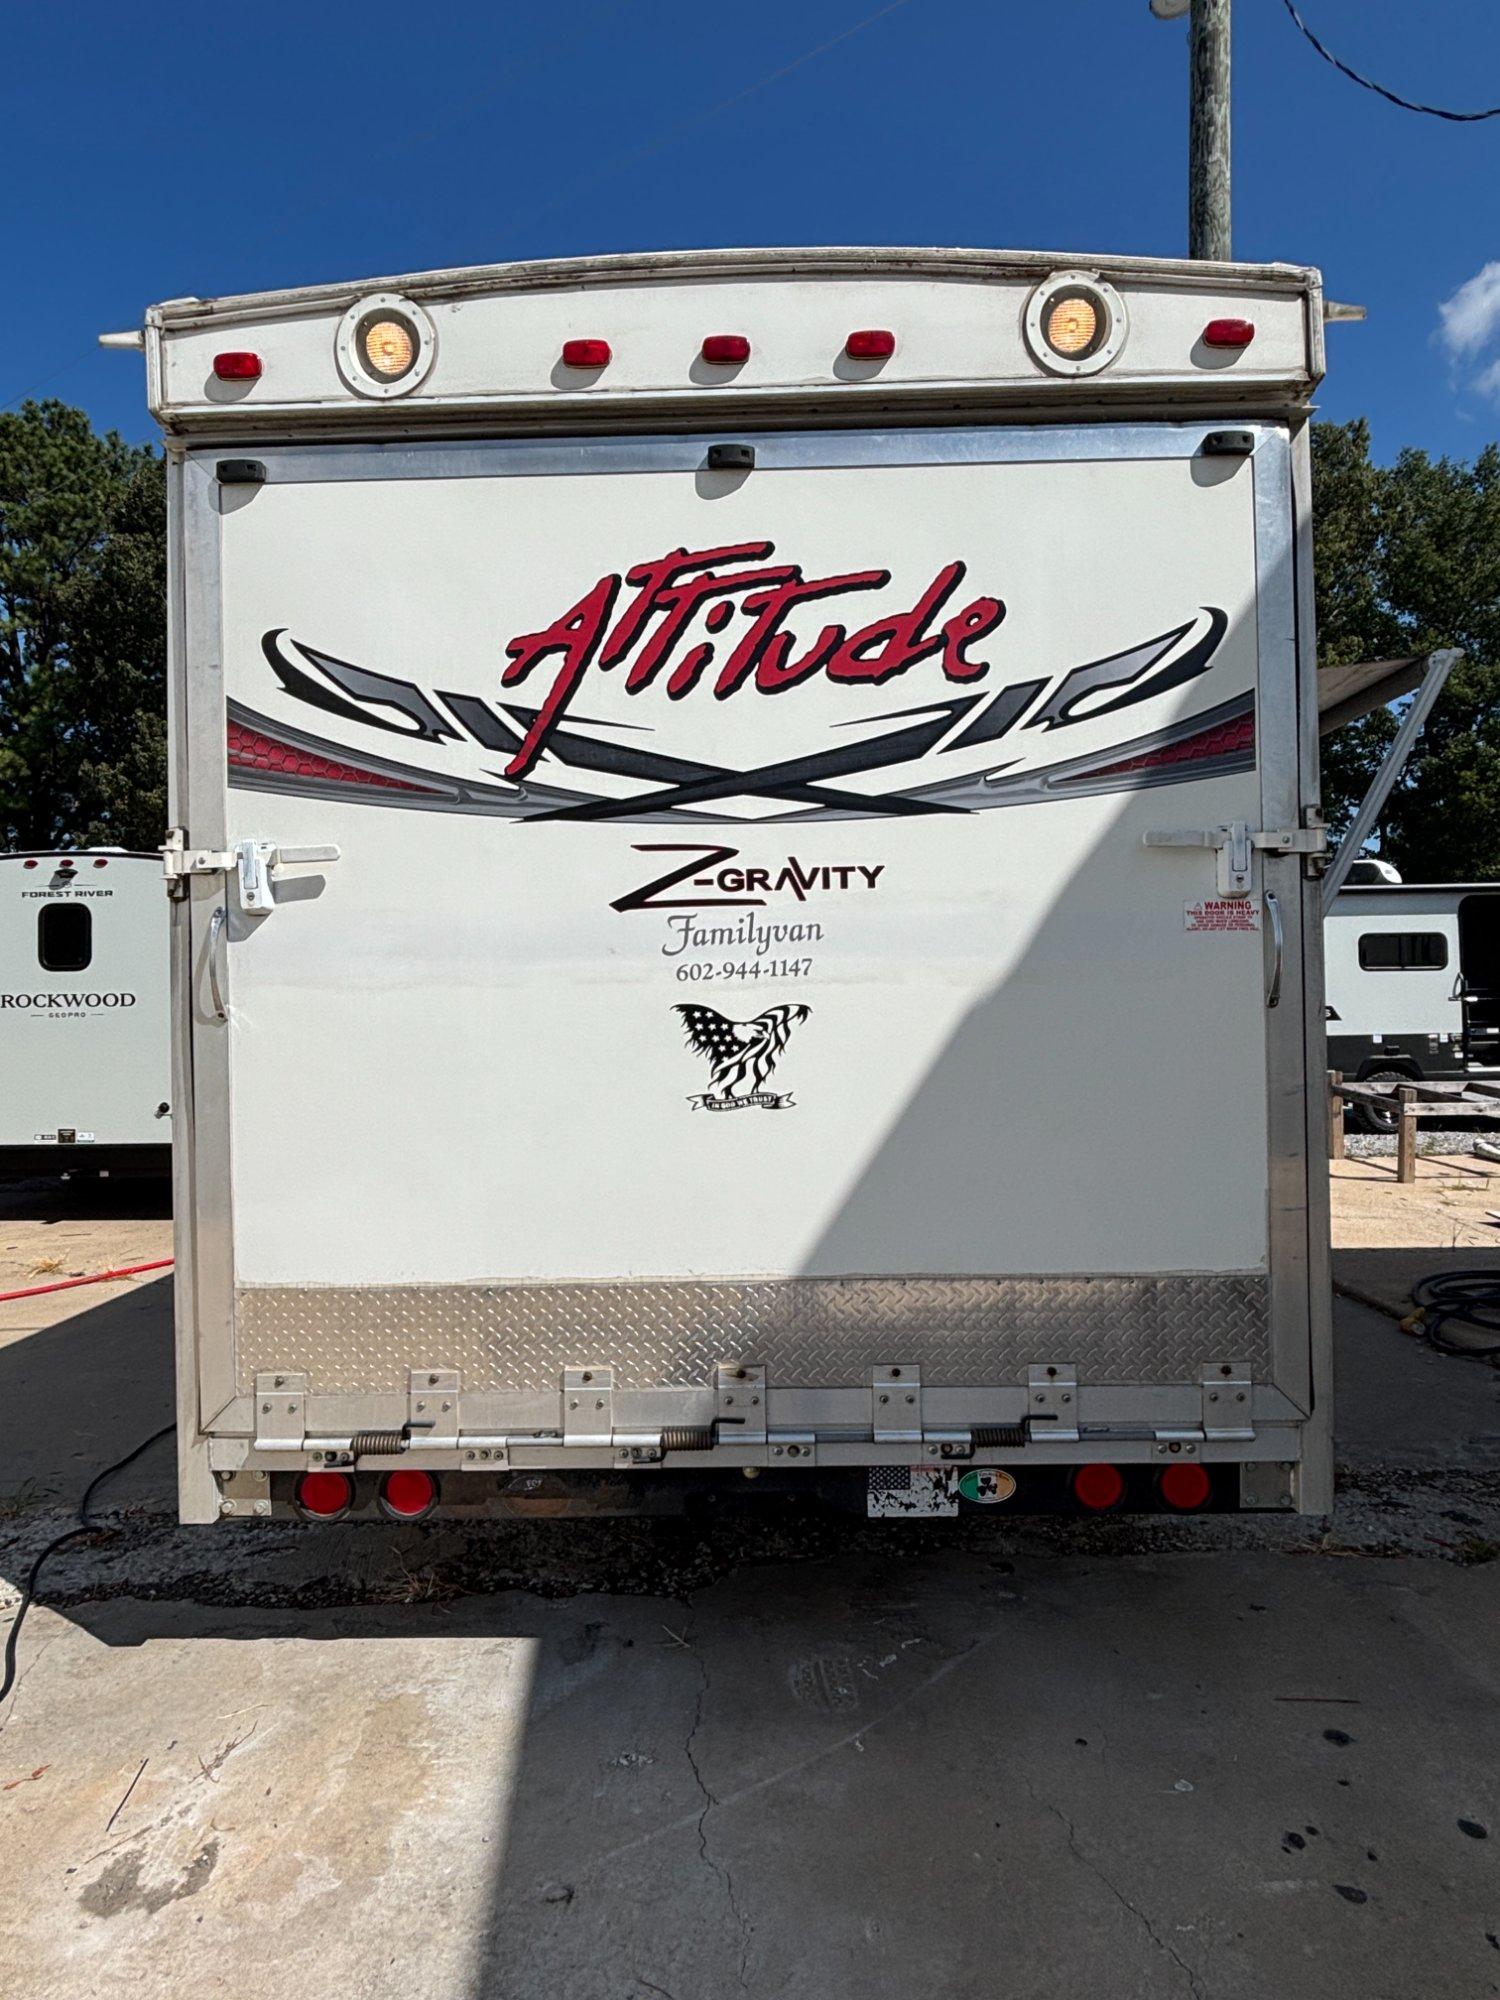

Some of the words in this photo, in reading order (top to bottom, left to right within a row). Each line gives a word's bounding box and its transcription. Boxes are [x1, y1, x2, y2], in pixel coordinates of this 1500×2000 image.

[608, 843, 886, 913] Z-GRAVITY
[1204, 901, 1252, 910] WARNING
[661, 911, 824, 957] Familyvan
[675, 958, 814, 982] 602-944-1147
[0, 993, 136, 1008] ROCKWOOD
[749, 1095, 773, 1104] TRUST
